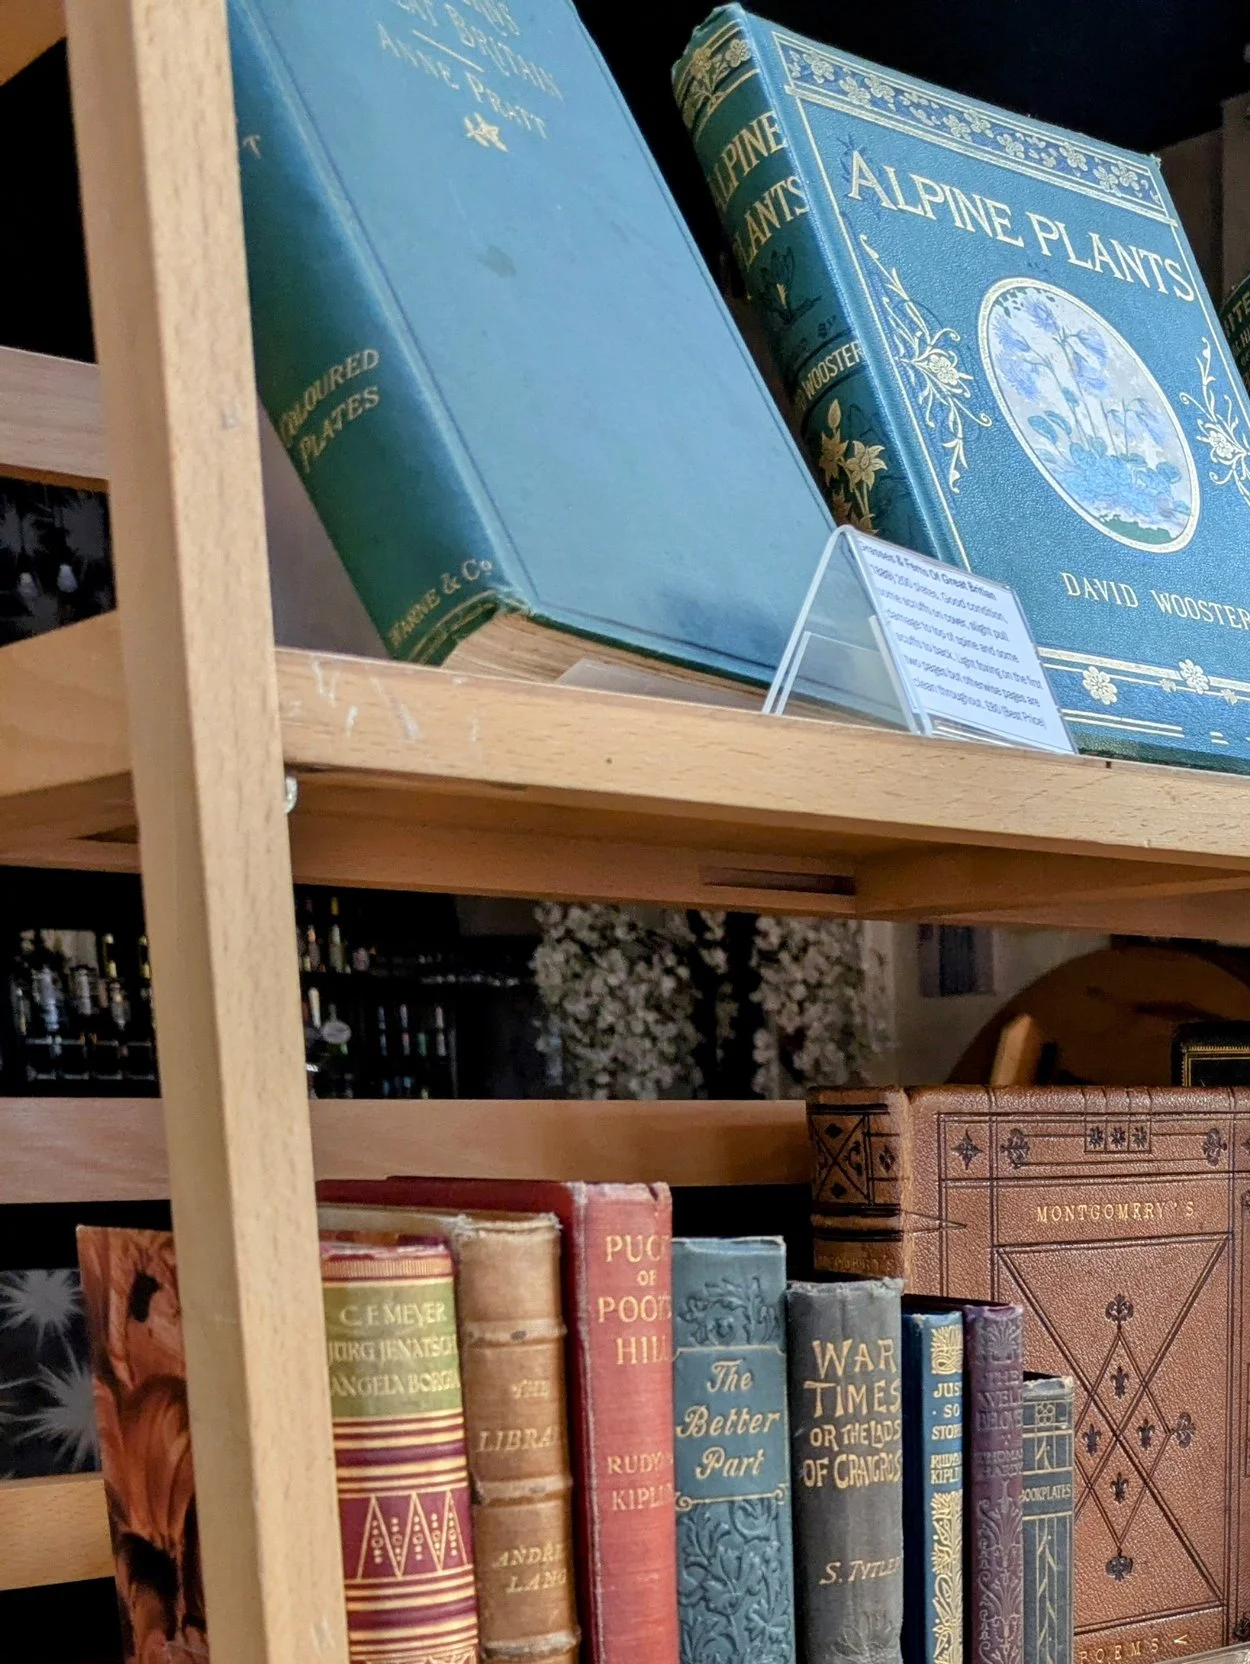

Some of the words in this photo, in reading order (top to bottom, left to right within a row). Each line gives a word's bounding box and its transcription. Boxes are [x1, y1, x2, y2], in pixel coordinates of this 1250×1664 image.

[848, 151, 1025, 247] ALPINE
[1025, 212, 1195, 301] PLANTS
[1059, 572, 1139, 608] DAVID
[1036, 1201, 1194, 1222] MONTGOMERY'S
[707, 1359, 752, 1392] The
[812, 1339, 897, 1379] WAR
[804, 1378, 902, 1418] TIMES
[676, 1405, 780, 1439] Better
[810, 1425, 839, 1451] OR
[843, 1425, 868, 1445] THE
[696, 1446, 765, 1480] Part
[804, 1457, 829, 1488] OF
